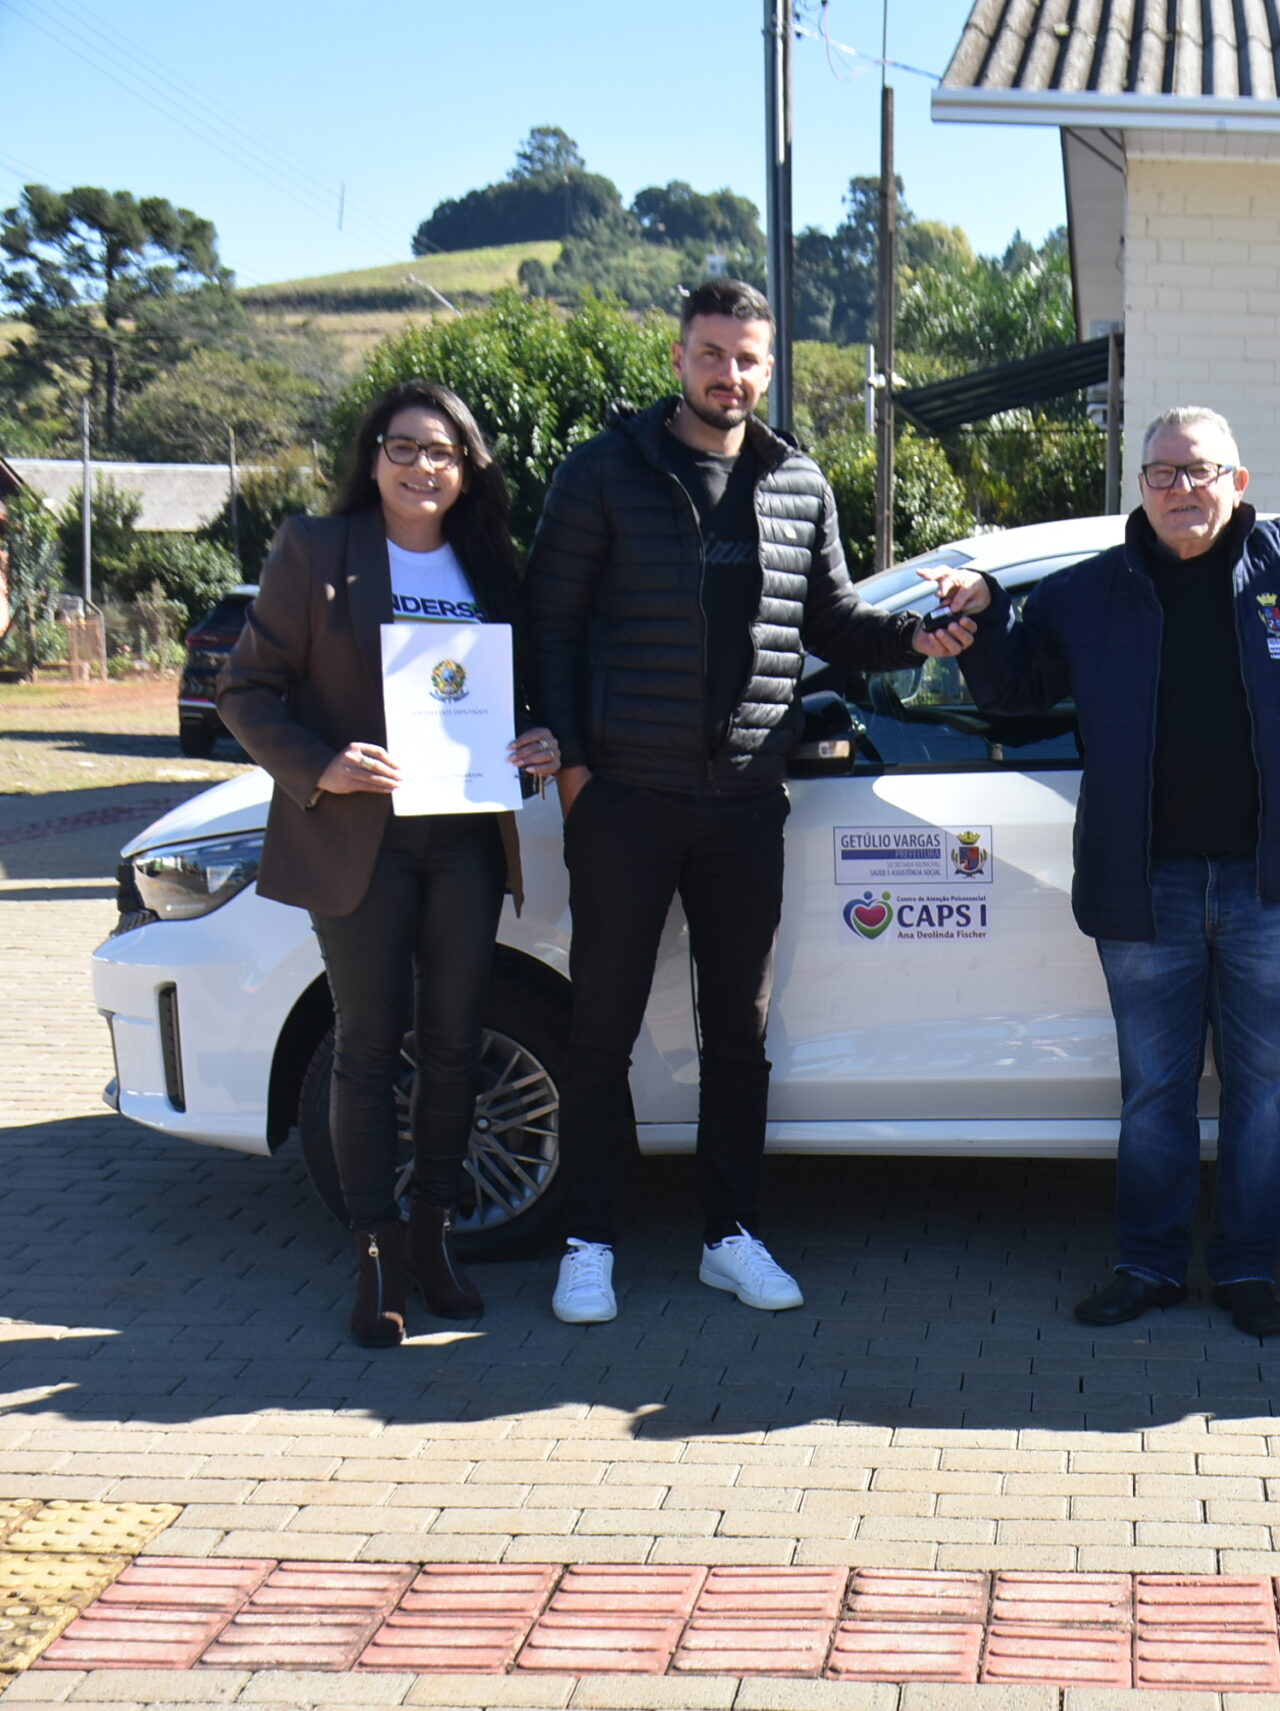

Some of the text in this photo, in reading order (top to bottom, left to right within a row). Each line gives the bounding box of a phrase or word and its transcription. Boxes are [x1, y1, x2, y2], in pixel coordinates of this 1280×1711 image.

[841, 832, 941, 848] GETÚLIO VARGAS
[895, 849, 941, 859] PREFEITURA
[926, 895, 949, 903] Atenção
[897, 904, 987, 928] CAPS I
[898, 930, 986, 939] Ana Deolinda Fischer
